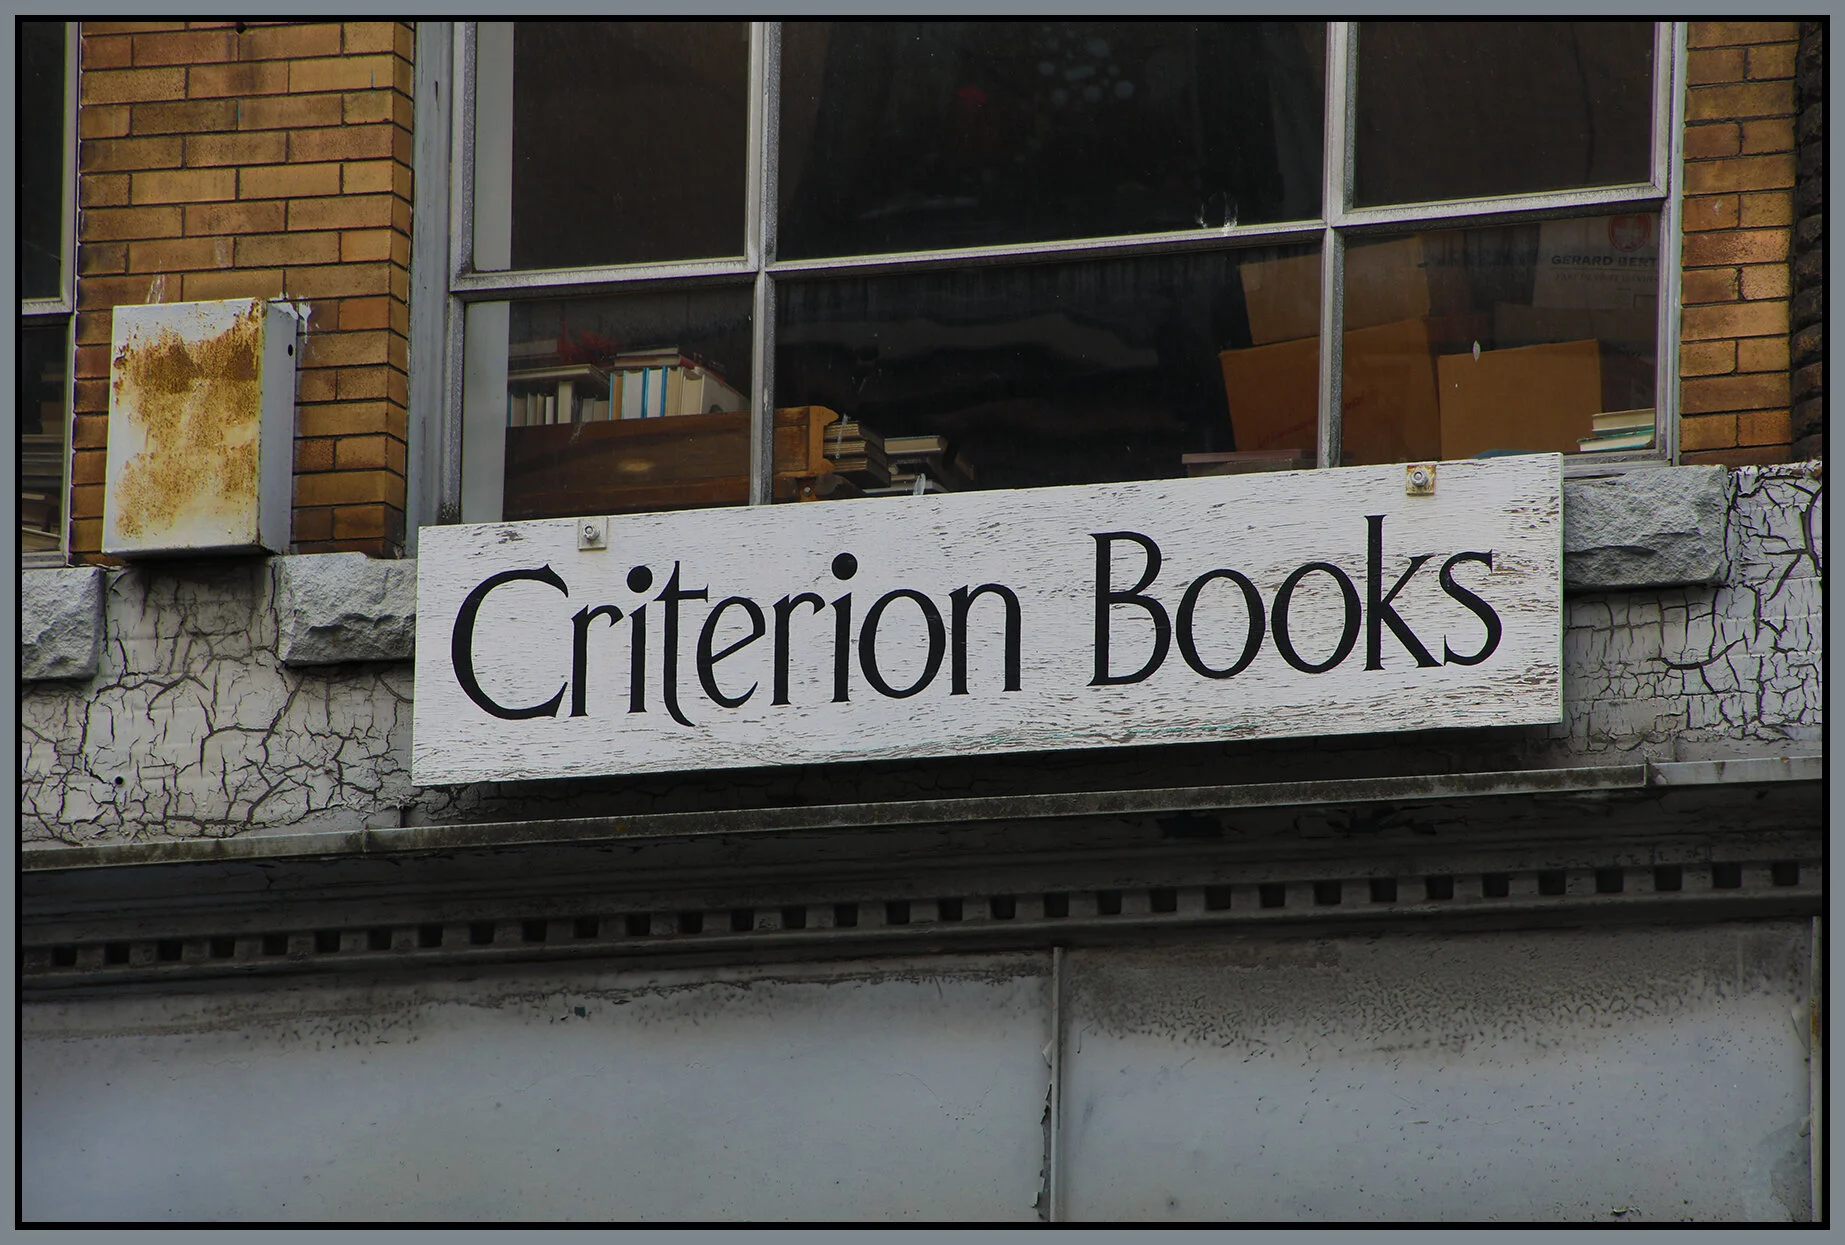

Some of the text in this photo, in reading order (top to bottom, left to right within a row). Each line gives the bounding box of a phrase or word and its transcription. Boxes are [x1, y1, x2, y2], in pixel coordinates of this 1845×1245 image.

[1551, 255, 1613, 266] GERARD
[451, 514, 1502, 727] Criterion Books
